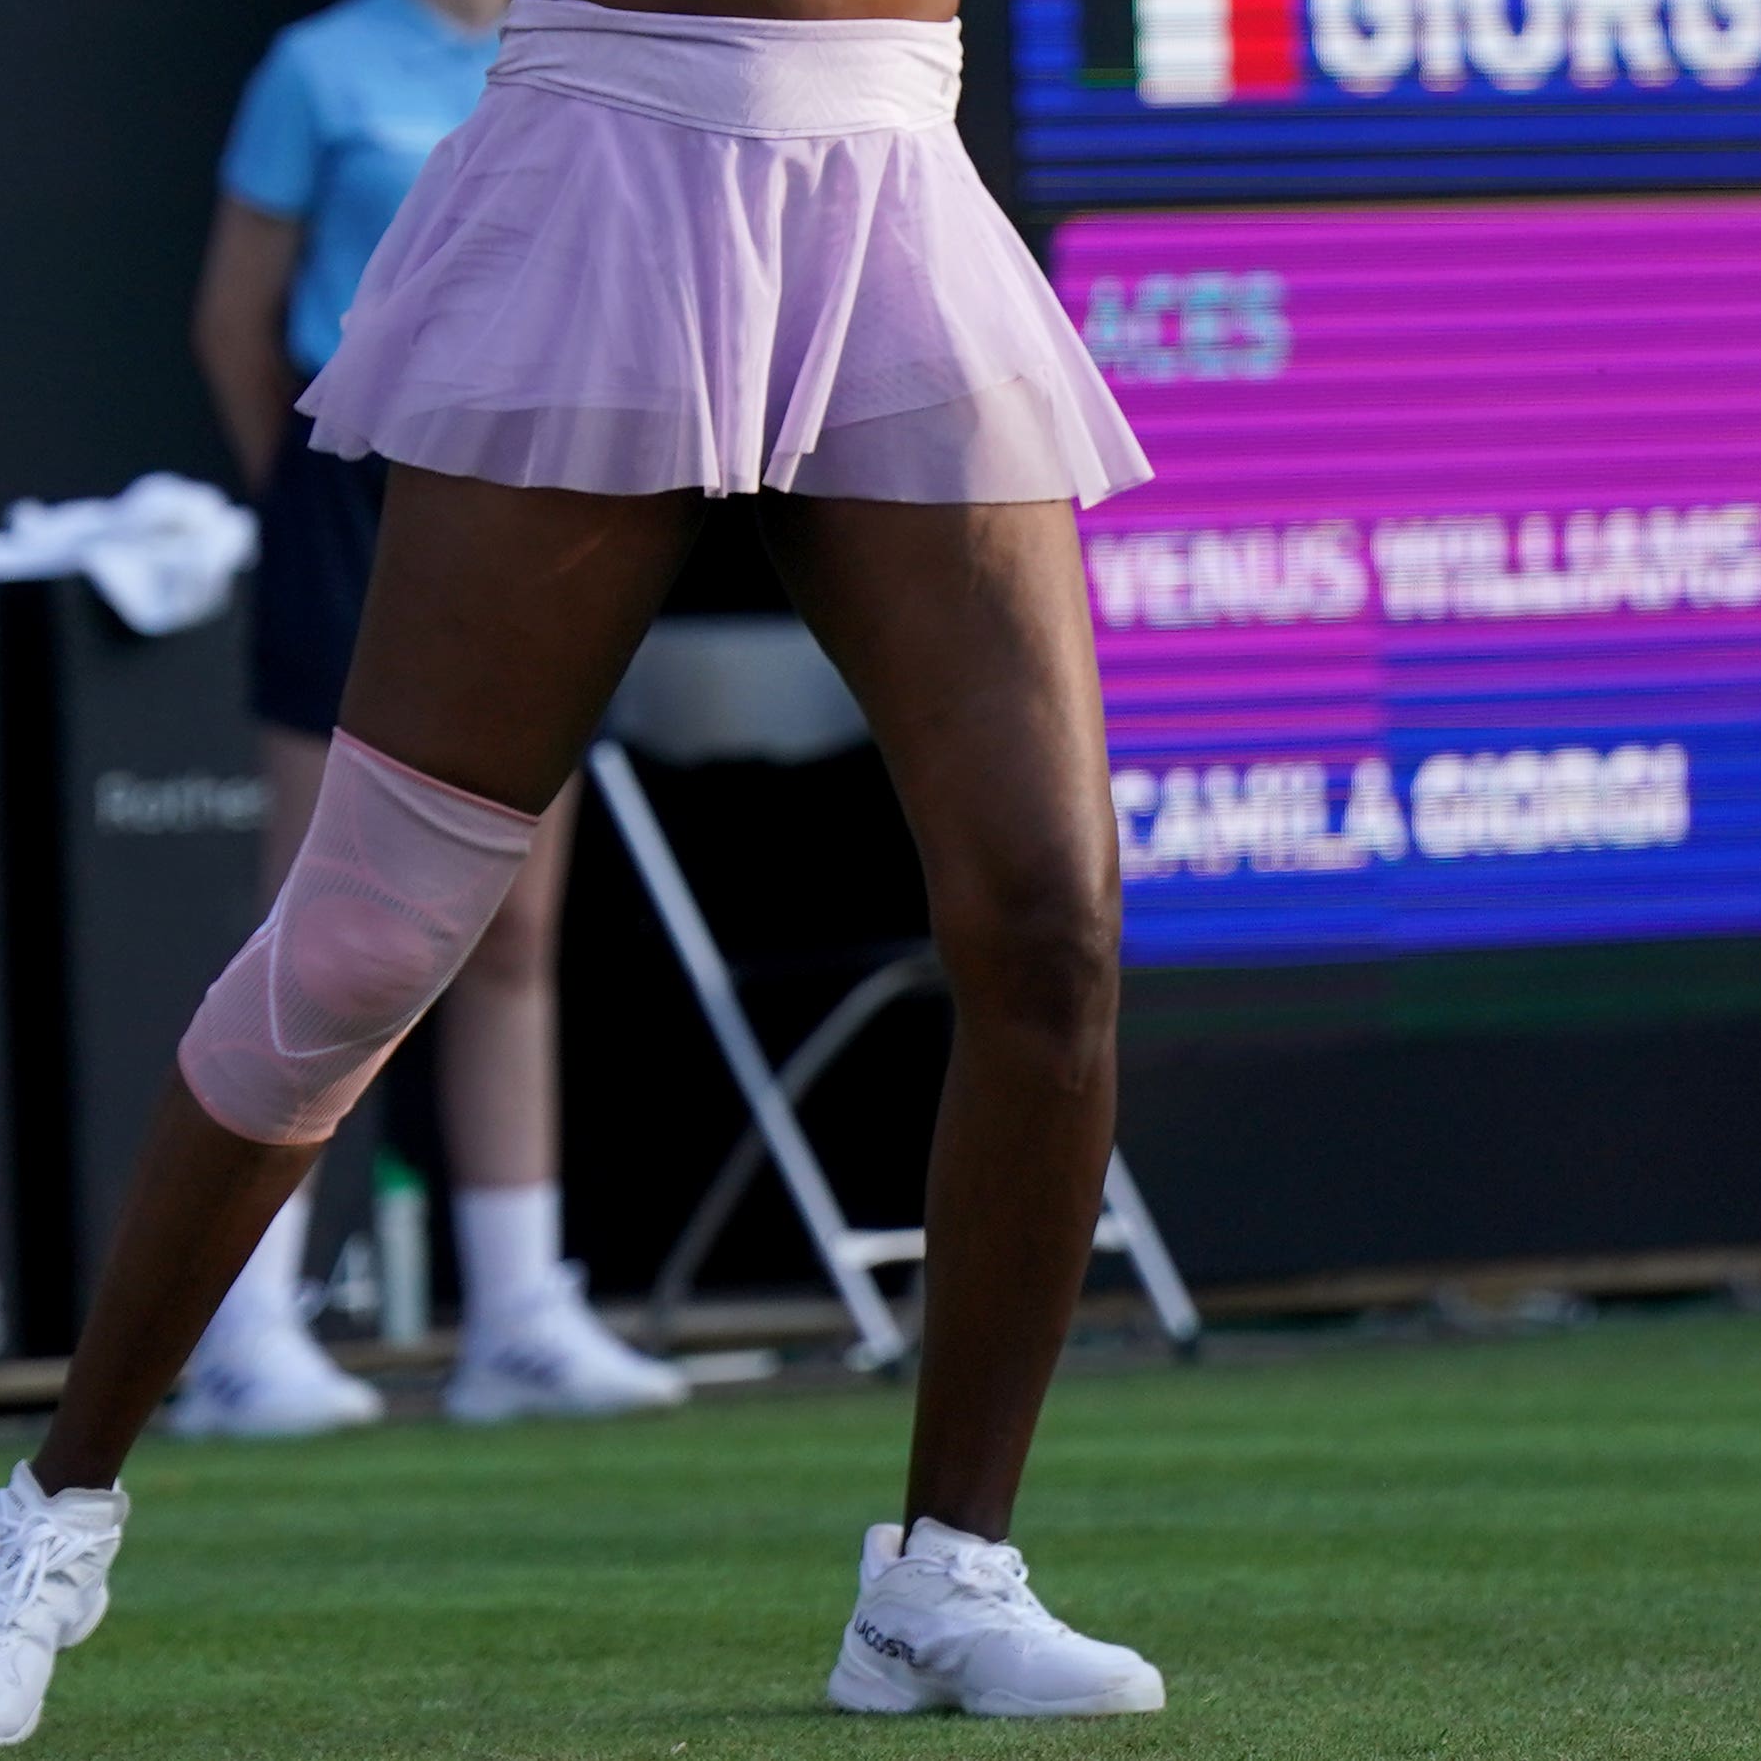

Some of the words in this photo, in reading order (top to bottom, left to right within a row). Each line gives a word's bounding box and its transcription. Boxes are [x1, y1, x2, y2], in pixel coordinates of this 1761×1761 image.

[1082, 271, 1294, 384] ACES
[1089, 521, 1370, 630] VENUS
[1111, 755, 1410, 881] CAMILA
[1410, 742, 1691, 861] GIORGI
